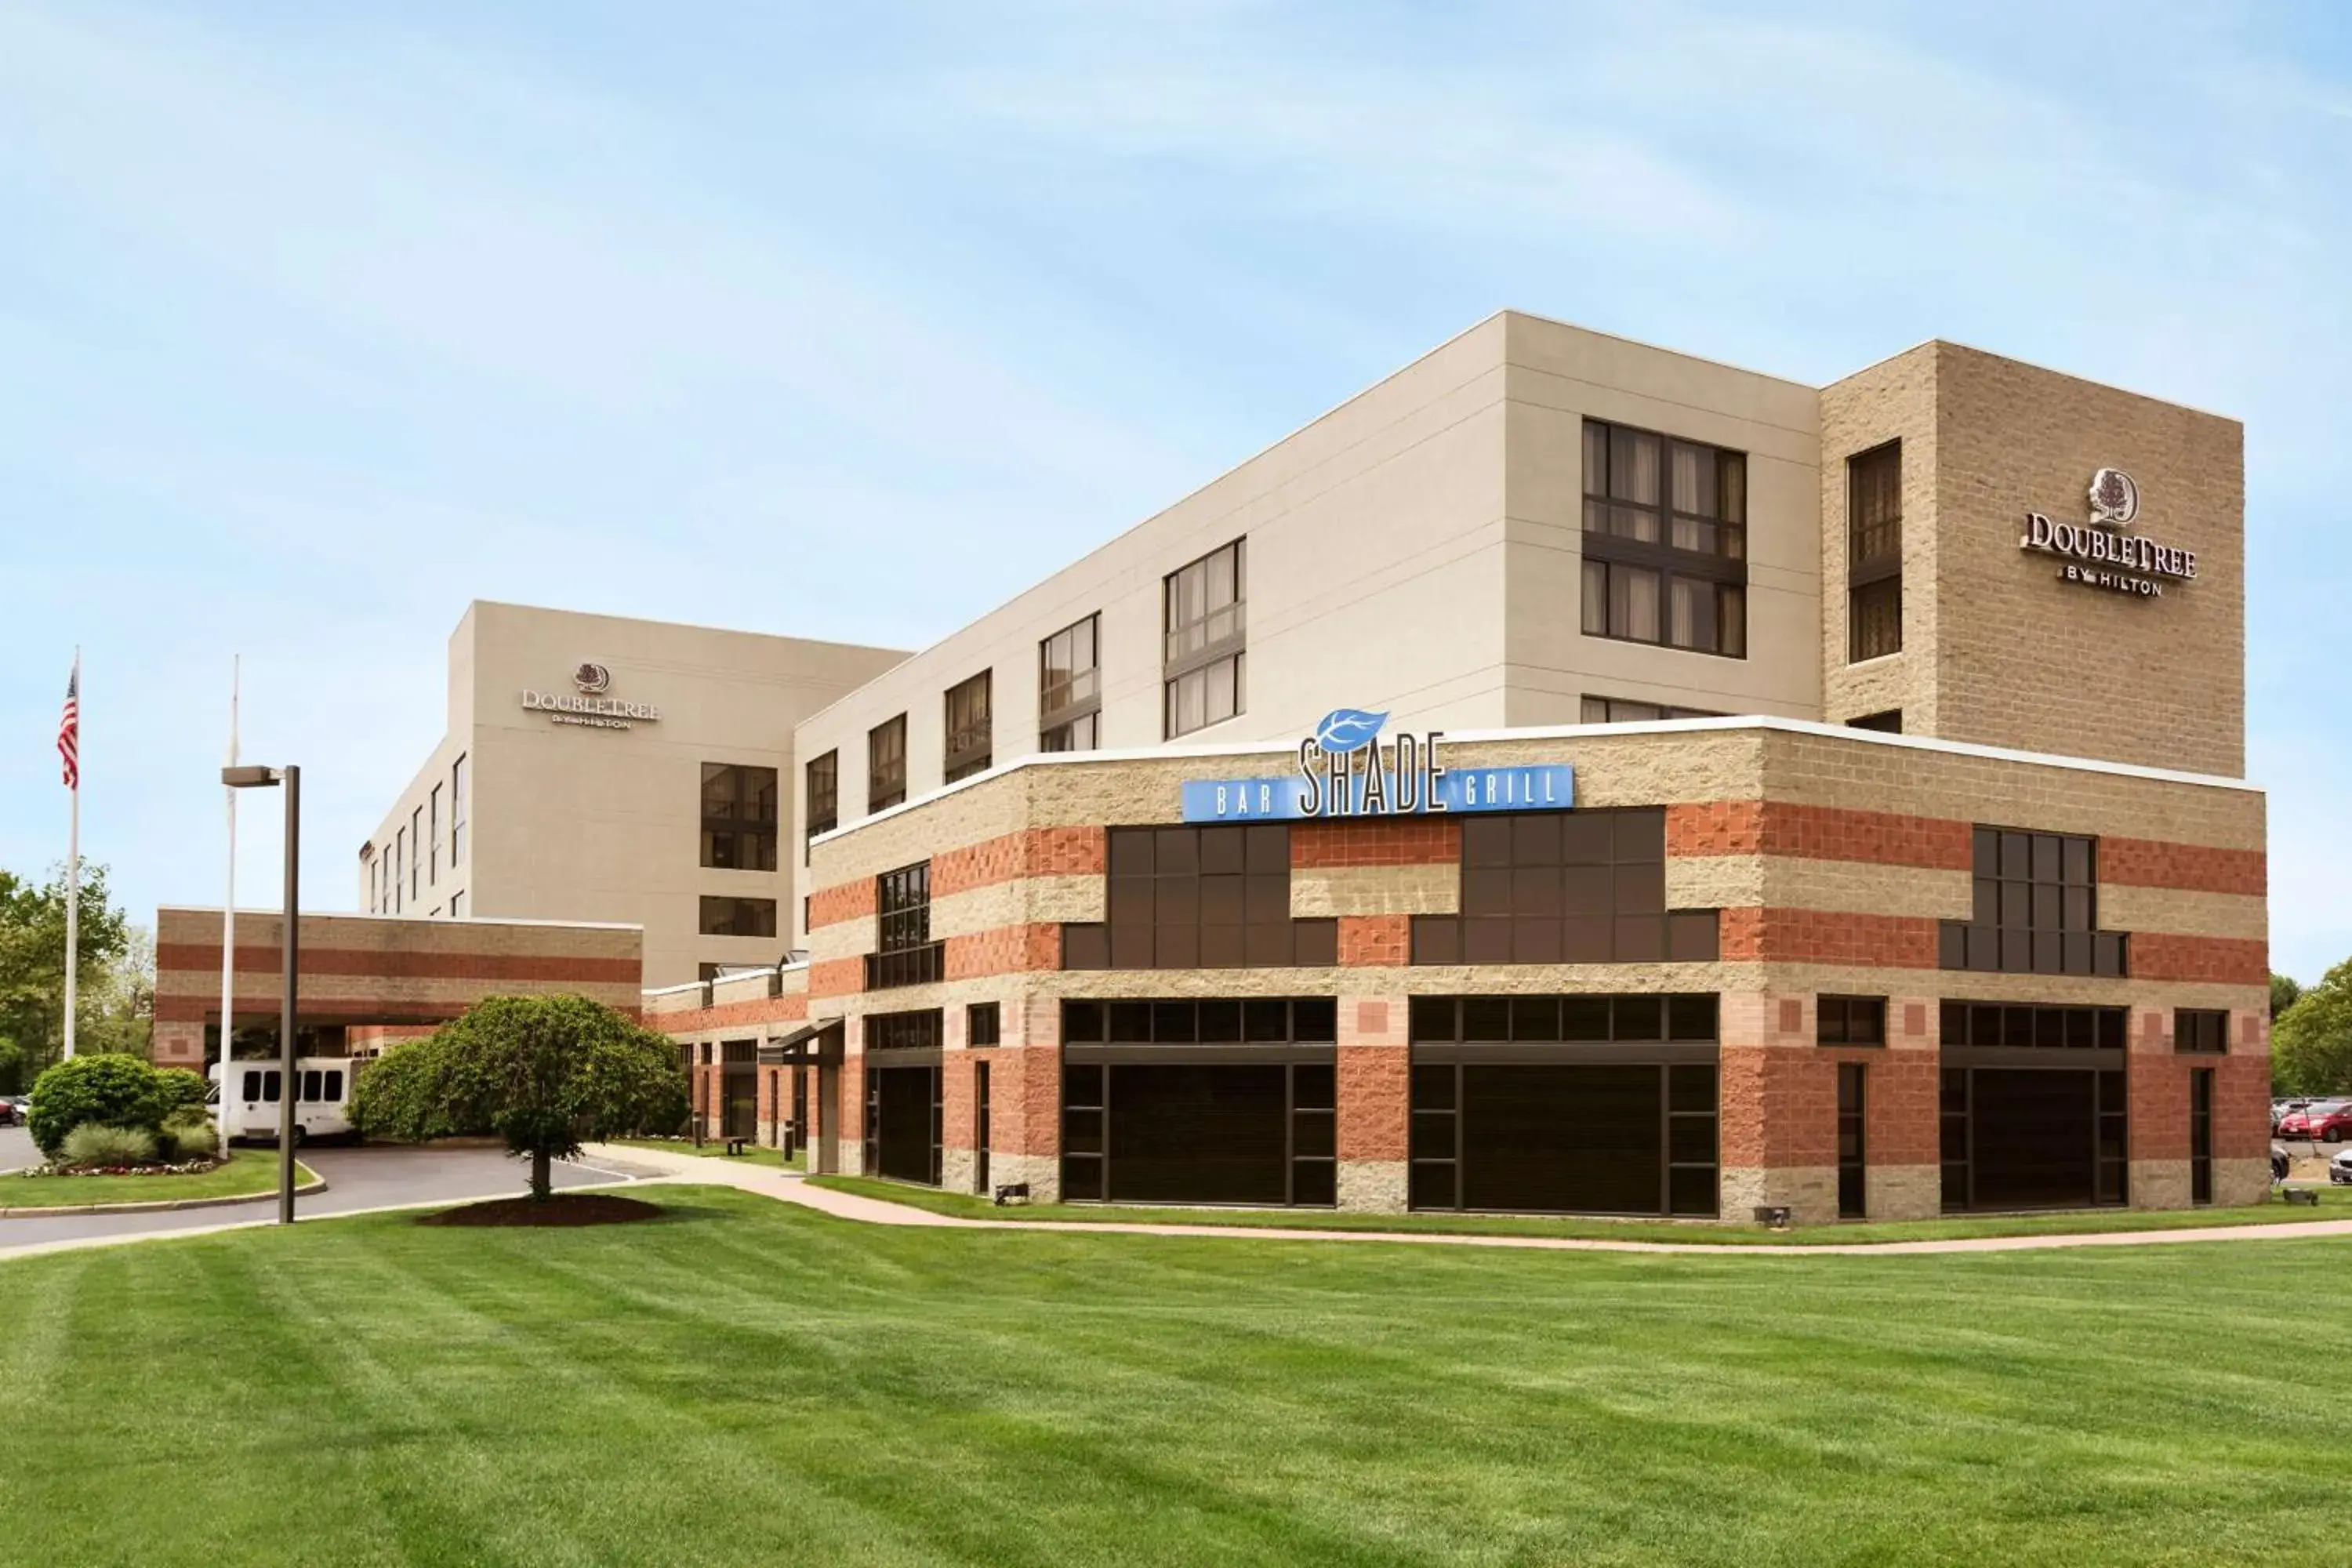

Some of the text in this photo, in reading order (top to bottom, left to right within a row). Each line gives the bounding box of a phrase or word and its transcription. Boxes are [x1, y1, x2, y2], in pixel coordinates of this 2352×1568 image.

[2066, 565, 2161, 596] BY HILTON
[579, 717, 631, 729] HILTON
[1216, 731, 1557, 816] BAR SHADE GRILL
